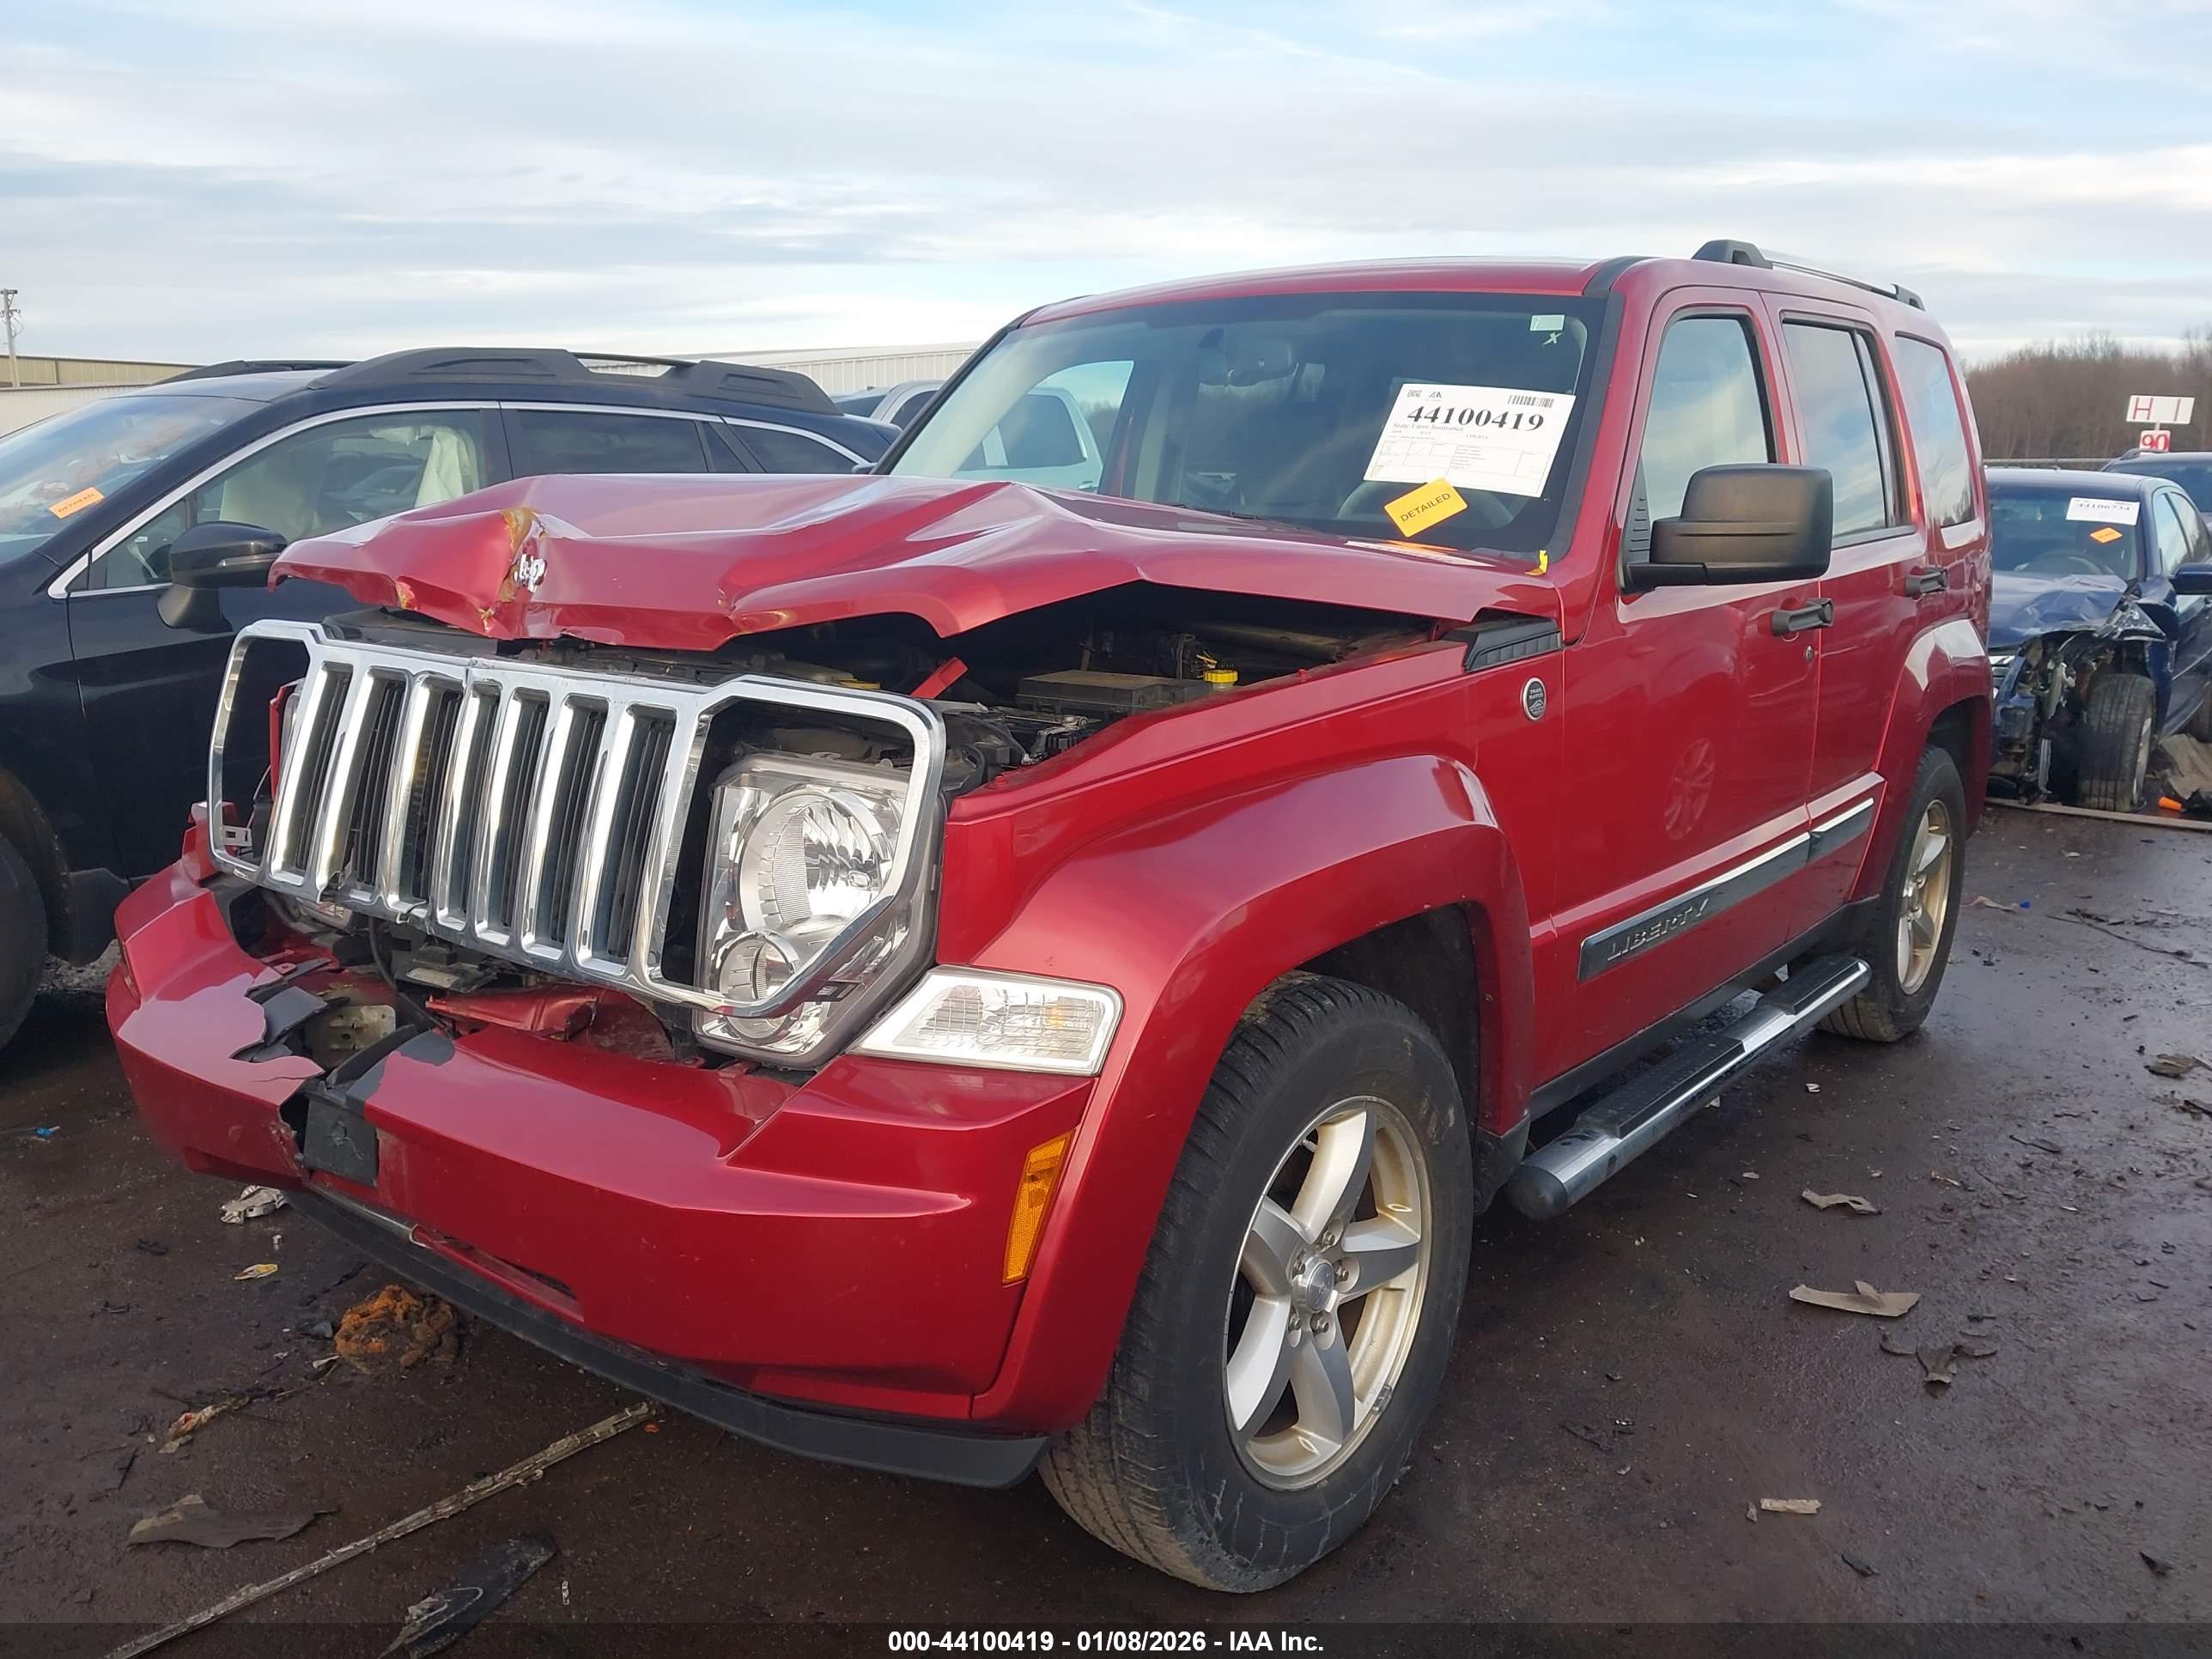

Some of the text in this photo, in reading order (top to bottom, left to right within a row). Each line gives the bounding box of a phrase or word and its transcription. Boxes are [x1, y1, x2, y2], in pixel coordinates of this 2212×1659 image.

[1407, 405, 1545, 431] 44100419
[2132, 398, 2154, 421] H
[2142, 434, 2170, 452] 90
[1400, 492, 1451, 523] DETAILED
[1607, 897, 1710, 962] LIBERTY
